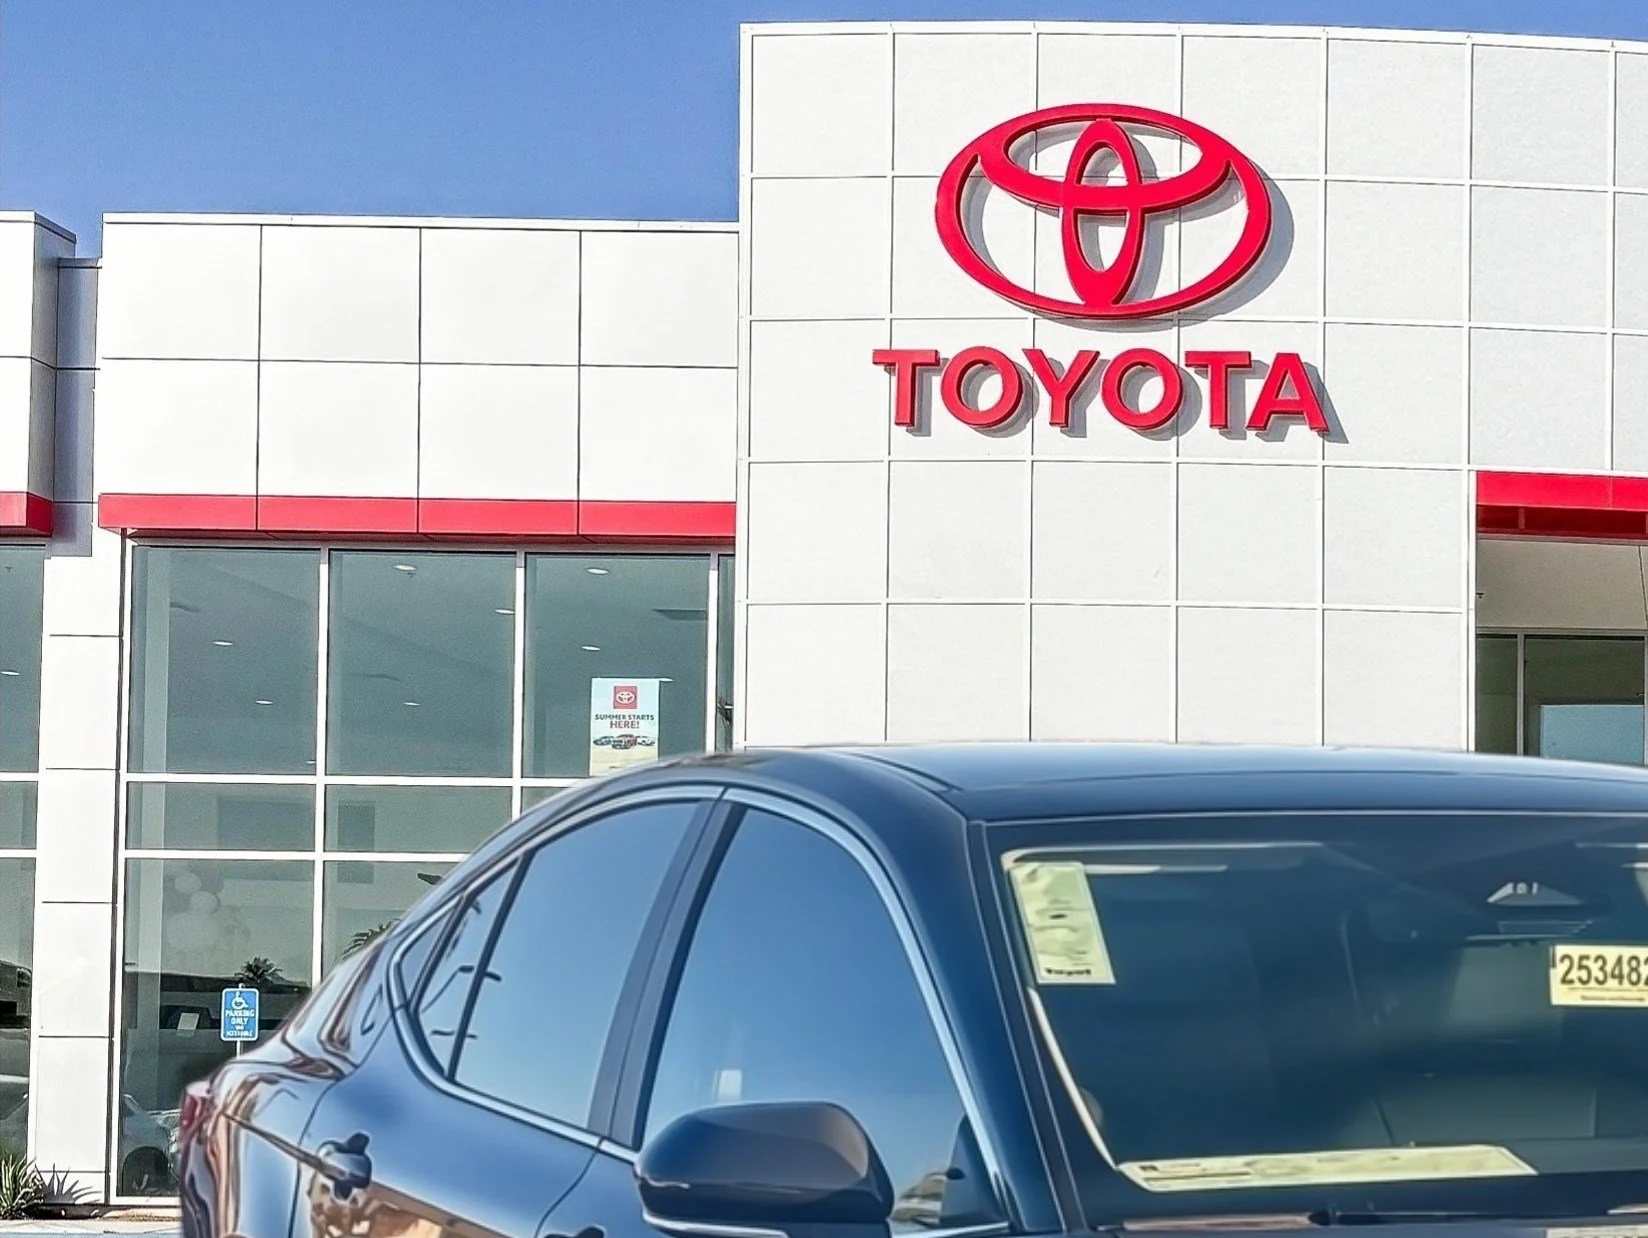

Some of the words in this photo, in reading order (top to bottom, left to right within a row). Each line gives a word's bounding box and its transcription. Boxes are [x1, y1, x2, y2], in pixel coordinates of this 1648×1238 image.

[872, 346, 1329, 432] TOYOTA
[609, 720, 640, 729] HERE!
[225, 1009, 255, 1018] PARKING
[230, 1017, 249, 1025] ONLY
